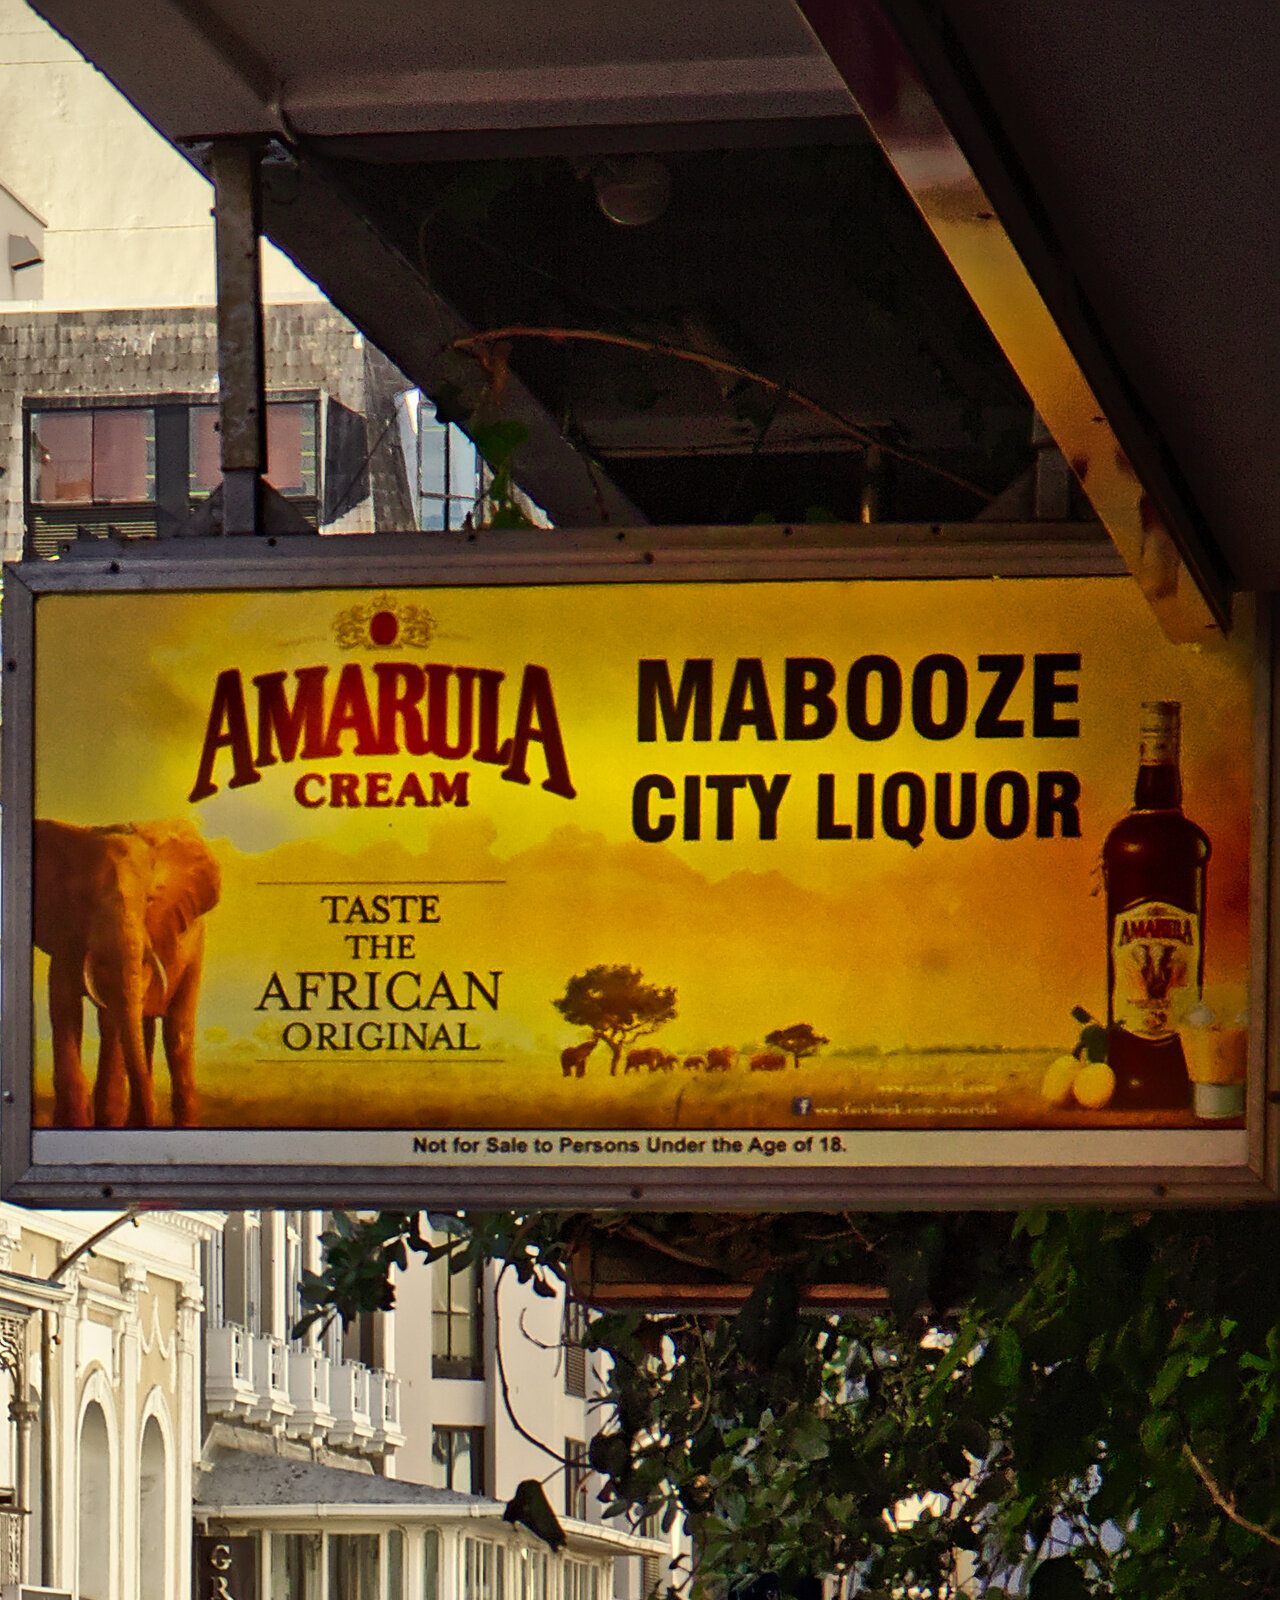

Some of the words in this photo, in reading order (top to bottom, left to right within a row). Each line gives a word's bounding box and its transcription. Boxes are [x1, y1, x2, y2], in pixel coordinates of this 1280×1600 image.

[637, 653, 1082, 743] MABOOZE
[189, 662, 577, 803] AMARULA
[294, 772, 470, 808] CREAM
[633, 774, 791, 843] CITY
[818, 771, 1082, 849] LIQUOR
[322, 895, 441, 924] TASTE
[345, 935, 416, 960] THE
[254, 972, 503, 1012] AFRICAN
[282, 1022, 481, 1052] ORIGINAL
[413, 1137, 448, 1154] Not
[452, 1136, 480, 1154] for
[486, 1136, 528, 1154] Sale
[534, 1138, 554, 1154] to
[560, 1136, 640, 1154] Persons
[646, 1136, 706, 1154] Under
[712, 1137, 743, 1153] the
[747, 1136, 787, 1157] Age
[793, 1136, 814, 1153] of
[819, 1136, 847, 1153] 18.
